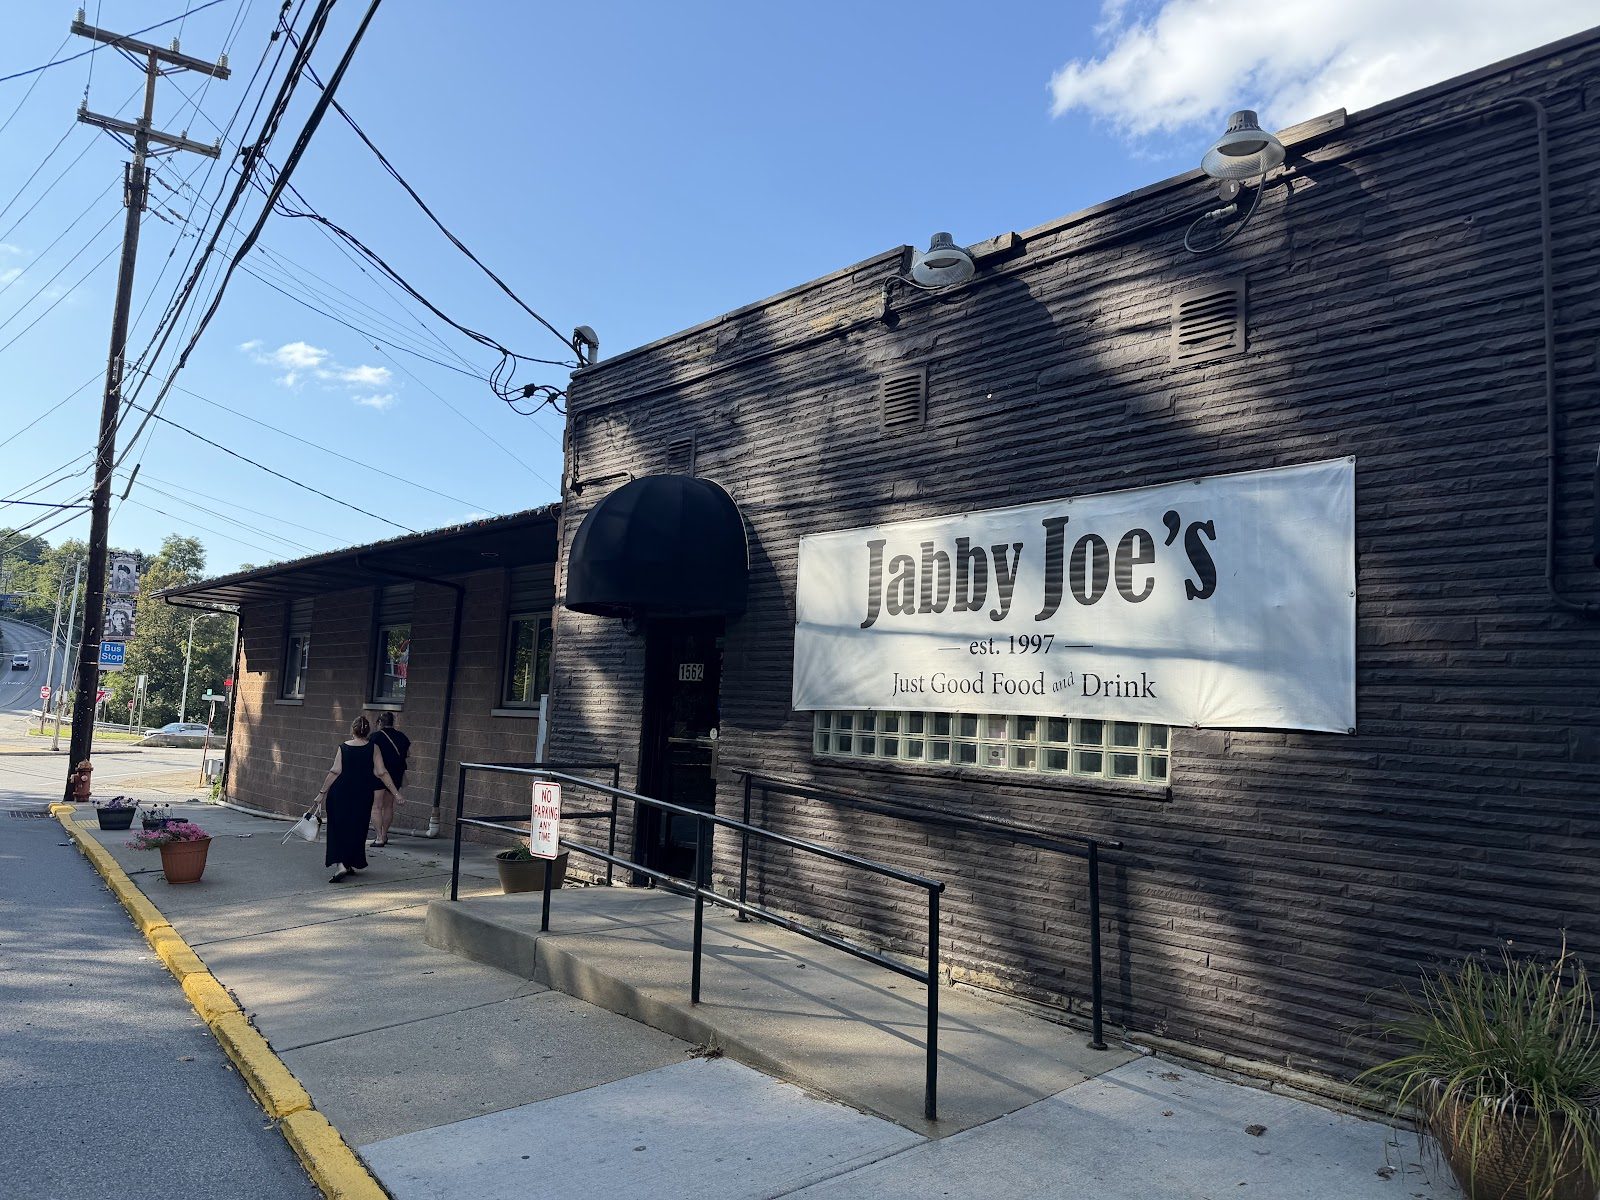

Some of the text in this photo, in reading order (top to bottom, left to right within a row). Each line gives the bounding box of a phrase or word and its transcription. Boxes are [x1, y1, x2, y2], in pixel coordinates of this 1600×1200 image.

[860, 510, 1217, 629] Jabby Joe's
[104, 644, 121, 652] Bus
[969, 634, 1055, 655] est. 1997
[101, 653, 122, 661] Stop
[681, 664, 703, 680] 1562
[892, 671, 1158, 699] Just Good Food and Drink
[542, 789, 552, 803] NO
[534, 804, 558, 820] PARKING
[539, 821, 551, 831] ANY
[538, 831, 551, 842] TIME
